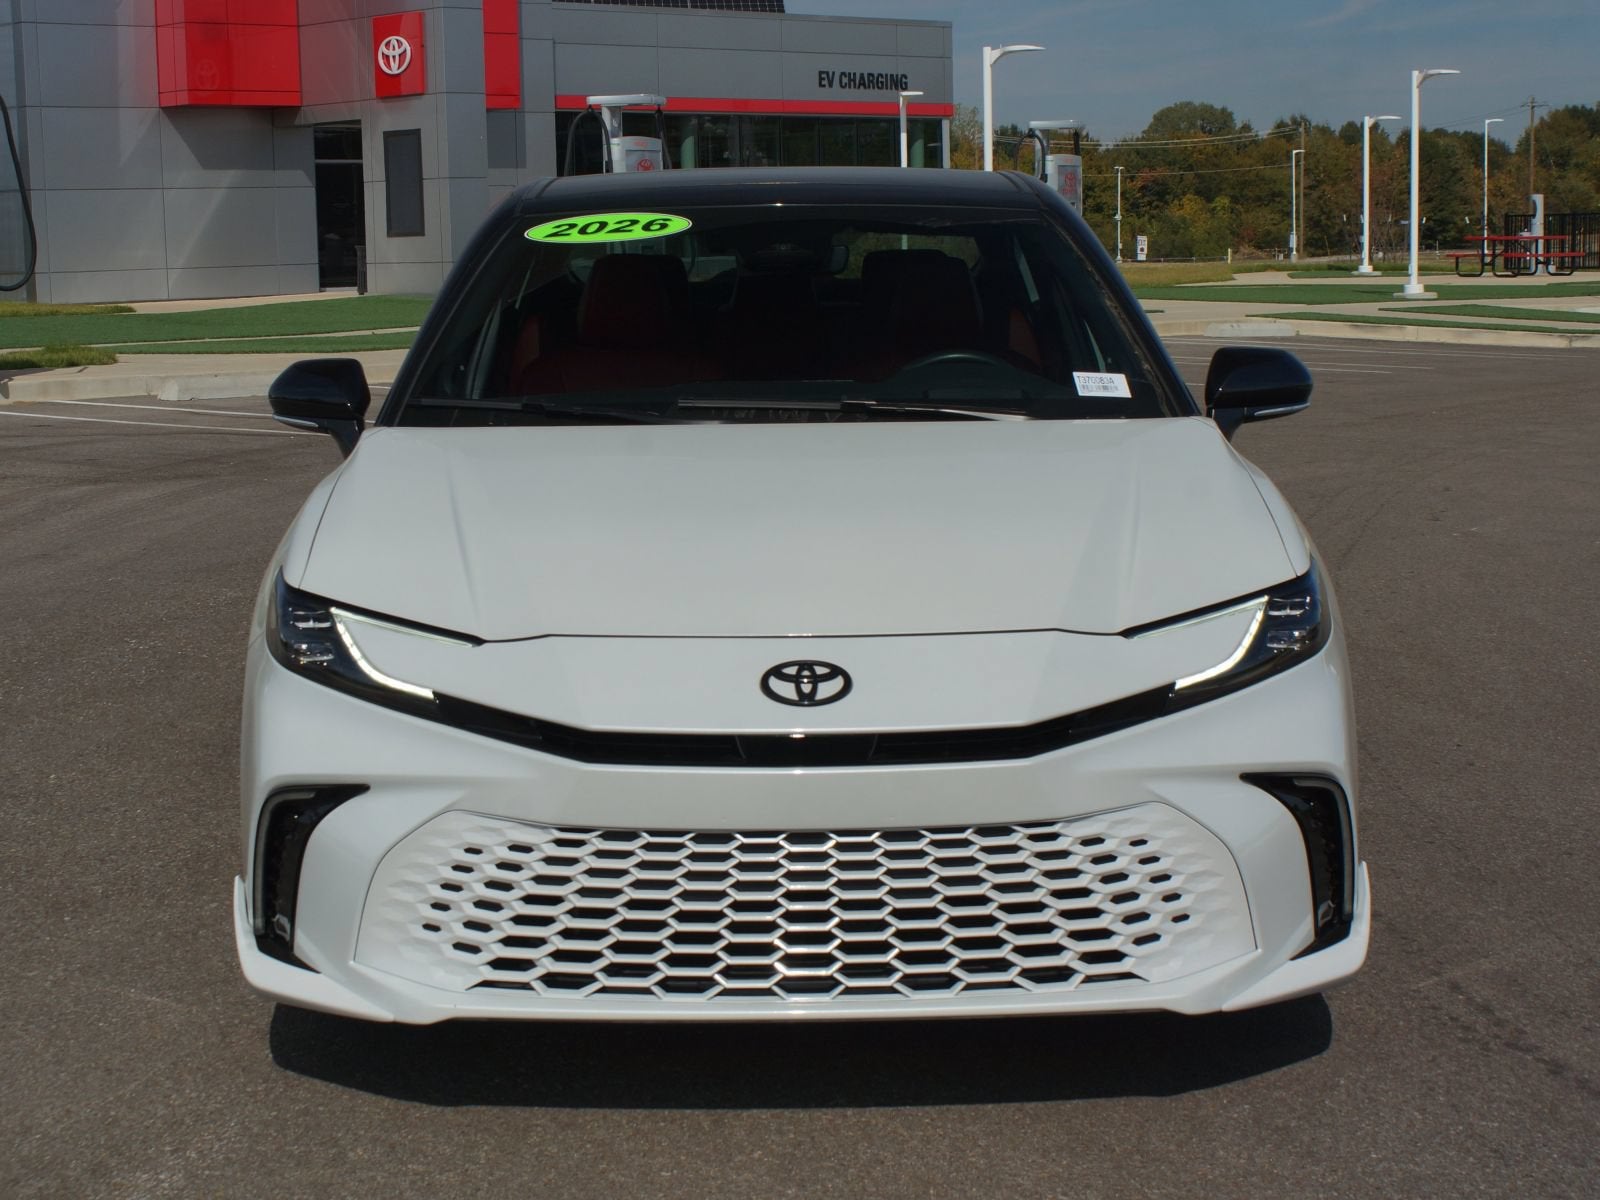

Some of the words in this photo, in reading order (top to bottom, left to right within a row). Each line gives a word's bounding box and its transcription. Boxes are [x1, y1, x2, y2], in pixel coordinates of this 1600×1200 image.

[818, 70, 836, 89] EV
[838, 71, 908, 91] CHARGING
[542, 218, 673, 239] 2026
